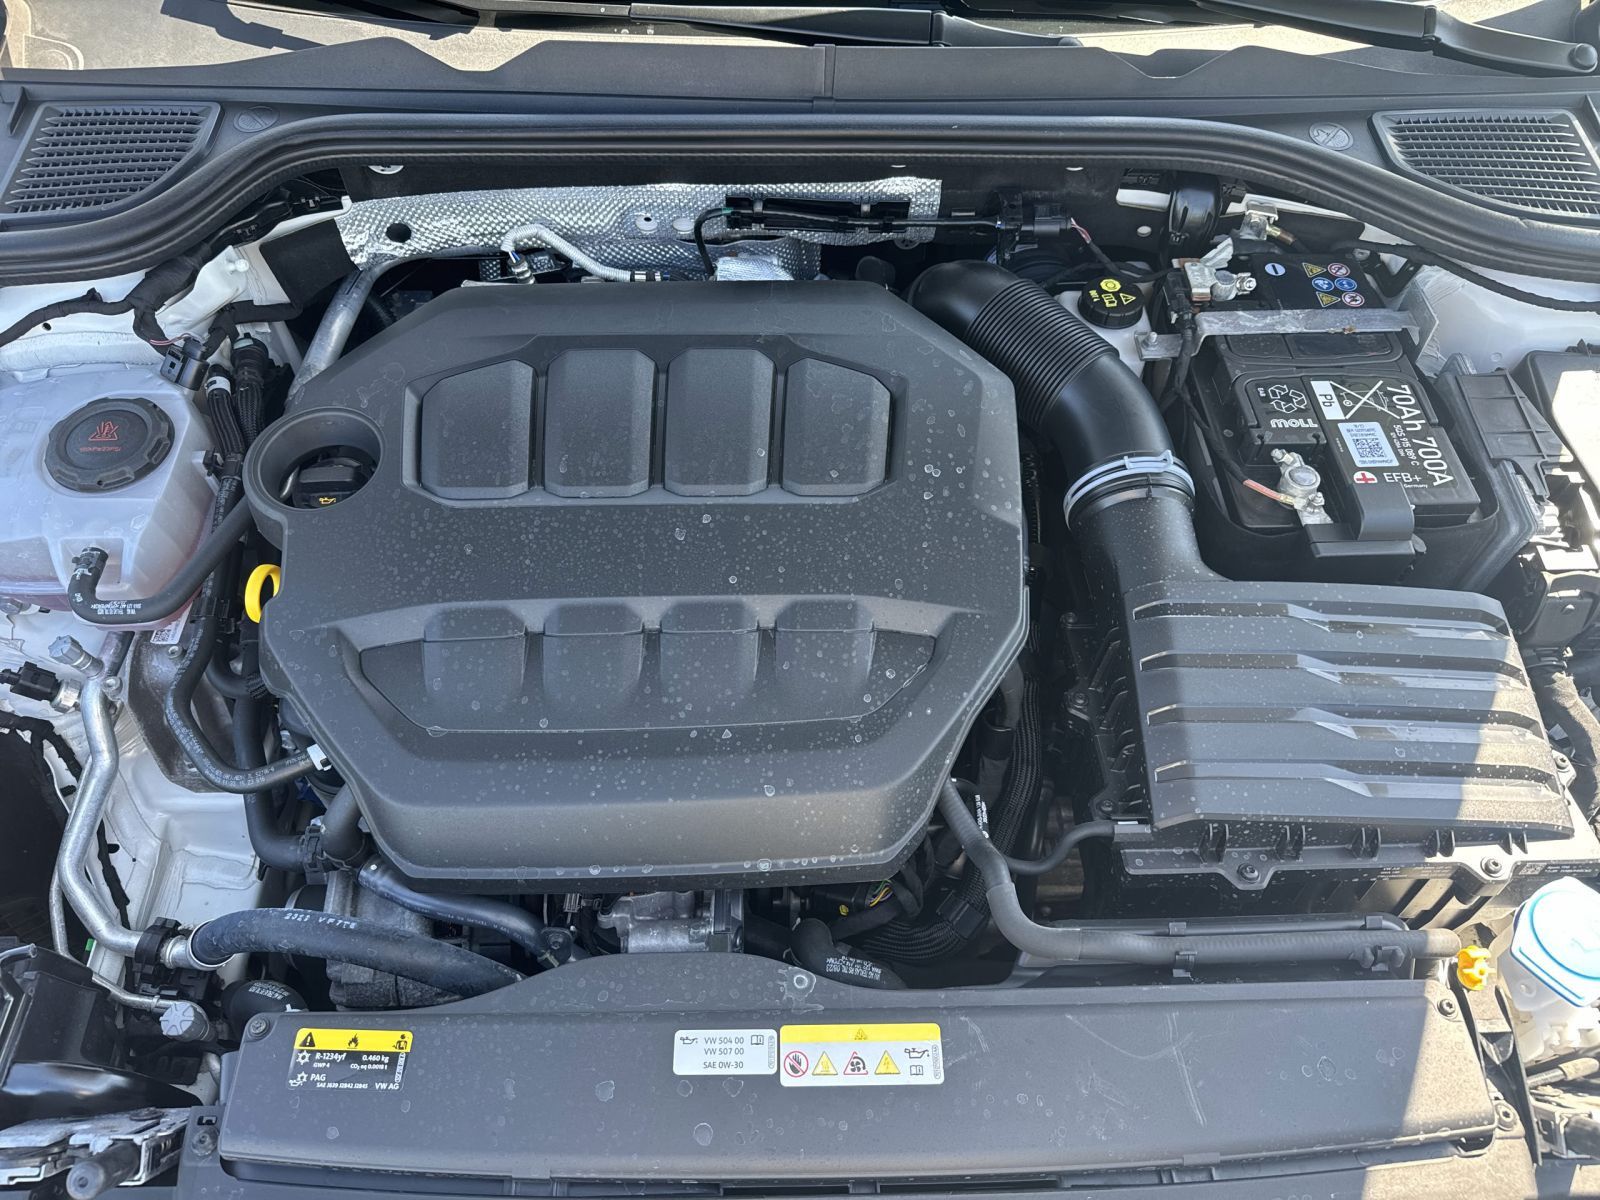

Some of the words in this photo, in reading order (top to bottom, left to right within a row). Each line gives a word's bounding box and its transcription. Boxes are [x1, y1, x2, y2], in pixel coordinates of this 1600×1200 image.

[1319, 394, 1335, 407] Pb
[1387, 384, 1426, 431] 70Ah
[1412, 437, 1454, 486] 700A
[1383, 472, 1422, 483] EFB+
[704, 1036, 717, 1044] VW
[719, 1036, 733, 1044] 504
[734, 1036, 745, 1044] 00
[704, 1047, 717, 1055] VW
[719, 1047, 733, 1055] 507
[734, 1047, 745, 1055] 00
[315, 1052, 347, 1063] R-1234yf
[381, 1055, 390, 1063] kg
[703, 1061, 717, 1069] SAE
[718, 1061, 744, 1069] 0W-30
[310, 1073, 327, 1082] PAG
[375, 1082, 388, 1090] VW
[388, 1082, 400, 1090] AG
